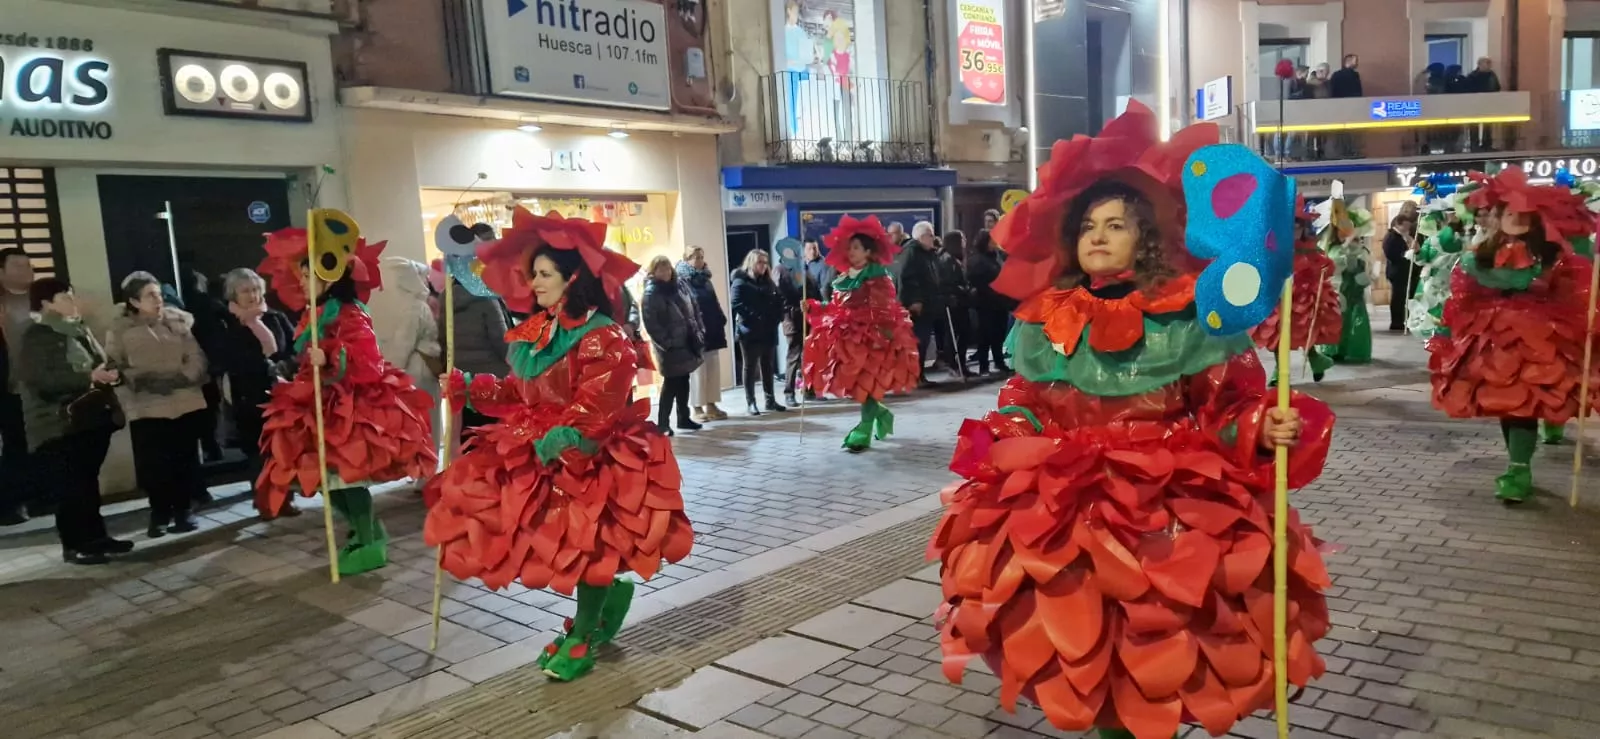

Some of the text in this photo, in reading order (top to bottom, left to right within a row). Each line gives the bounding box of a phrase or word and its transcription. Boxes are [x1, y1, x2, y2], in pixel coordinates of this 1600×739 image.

[536, 0, 655, 43] hitradio
[45, 36, 94, 52] 1888
[538, 33, 658, 65] Huesca 107.1fm
[0, 55, 110, 106] as
[1387, 101, 1420, 110] REALE
[10, 117, 112, 140] AUDITIVO
